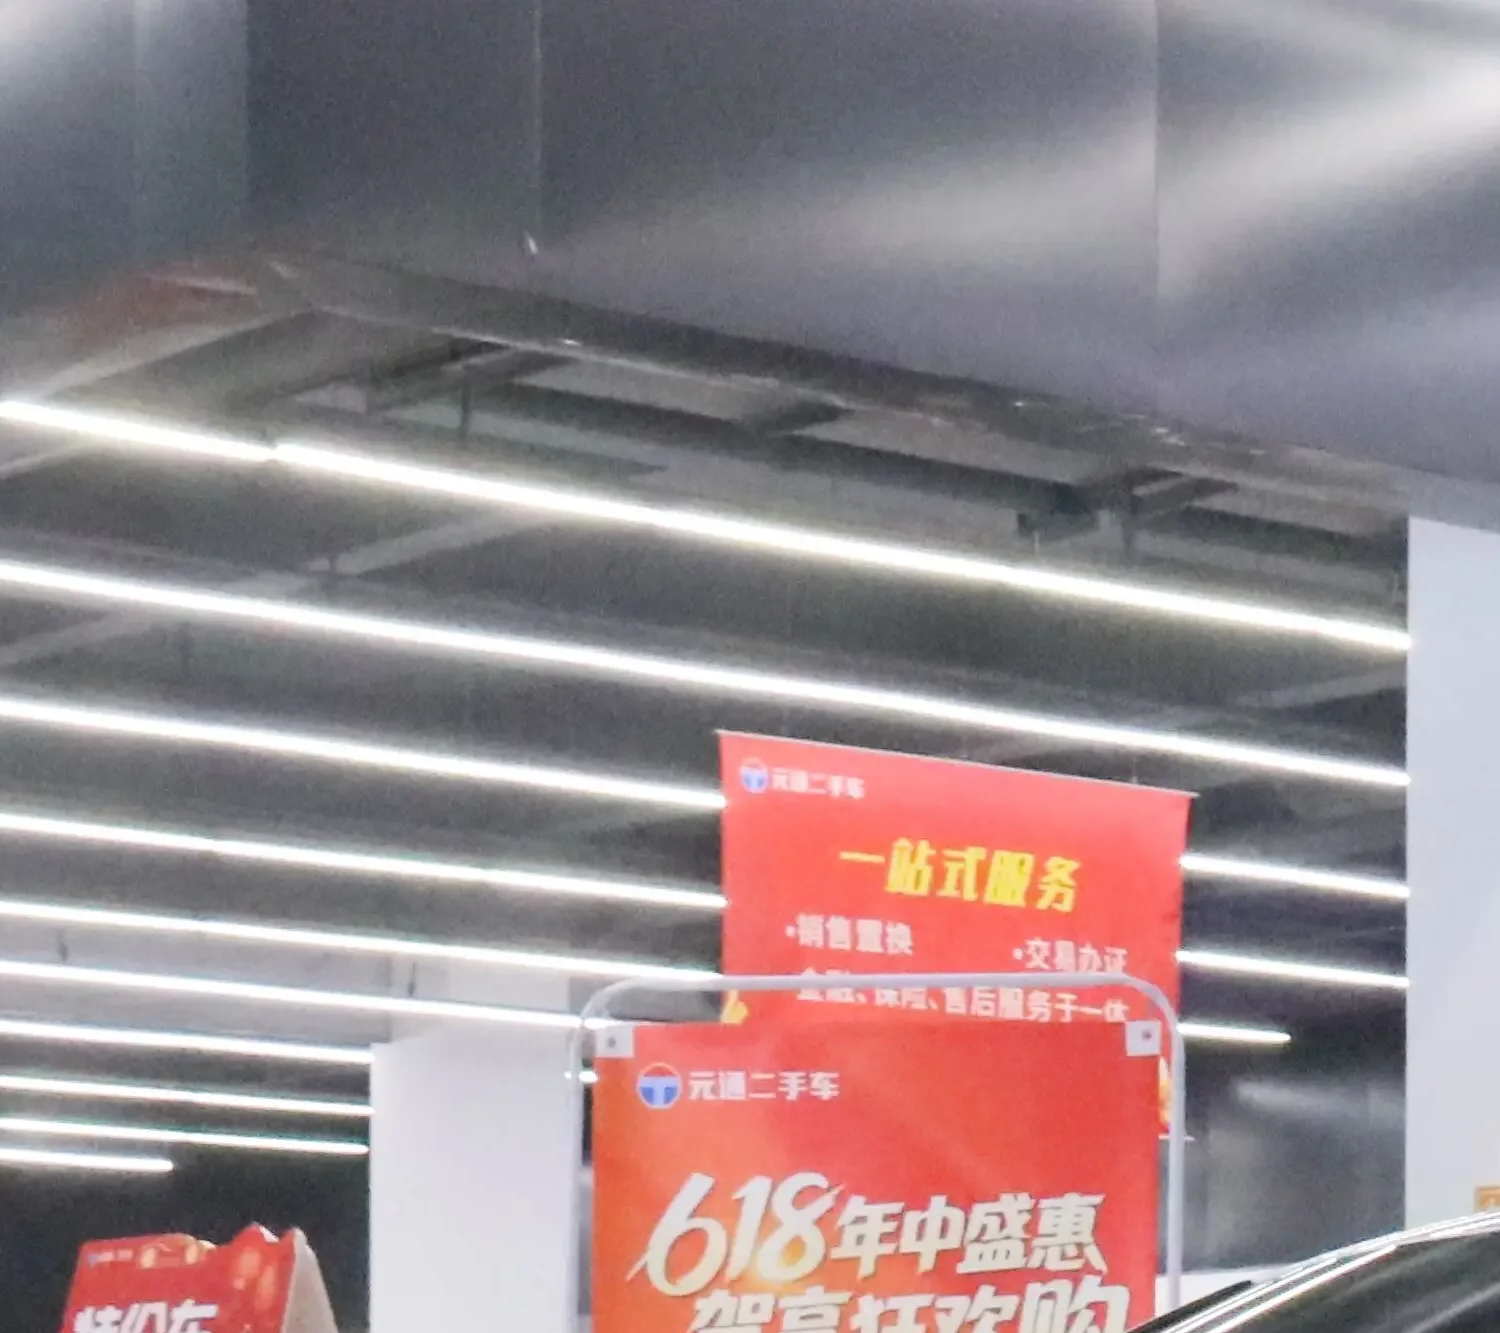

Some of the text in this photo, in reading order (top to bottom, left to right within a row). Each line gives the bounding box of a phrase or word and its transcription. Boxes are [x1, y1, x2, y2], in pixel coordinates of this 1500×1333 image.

[839, 836, 1083, 914] 一站式服务
[687, 1070, 840, 1101] 元通二手车
[628, 1172, 1107, 1296] 618年中盛惠
